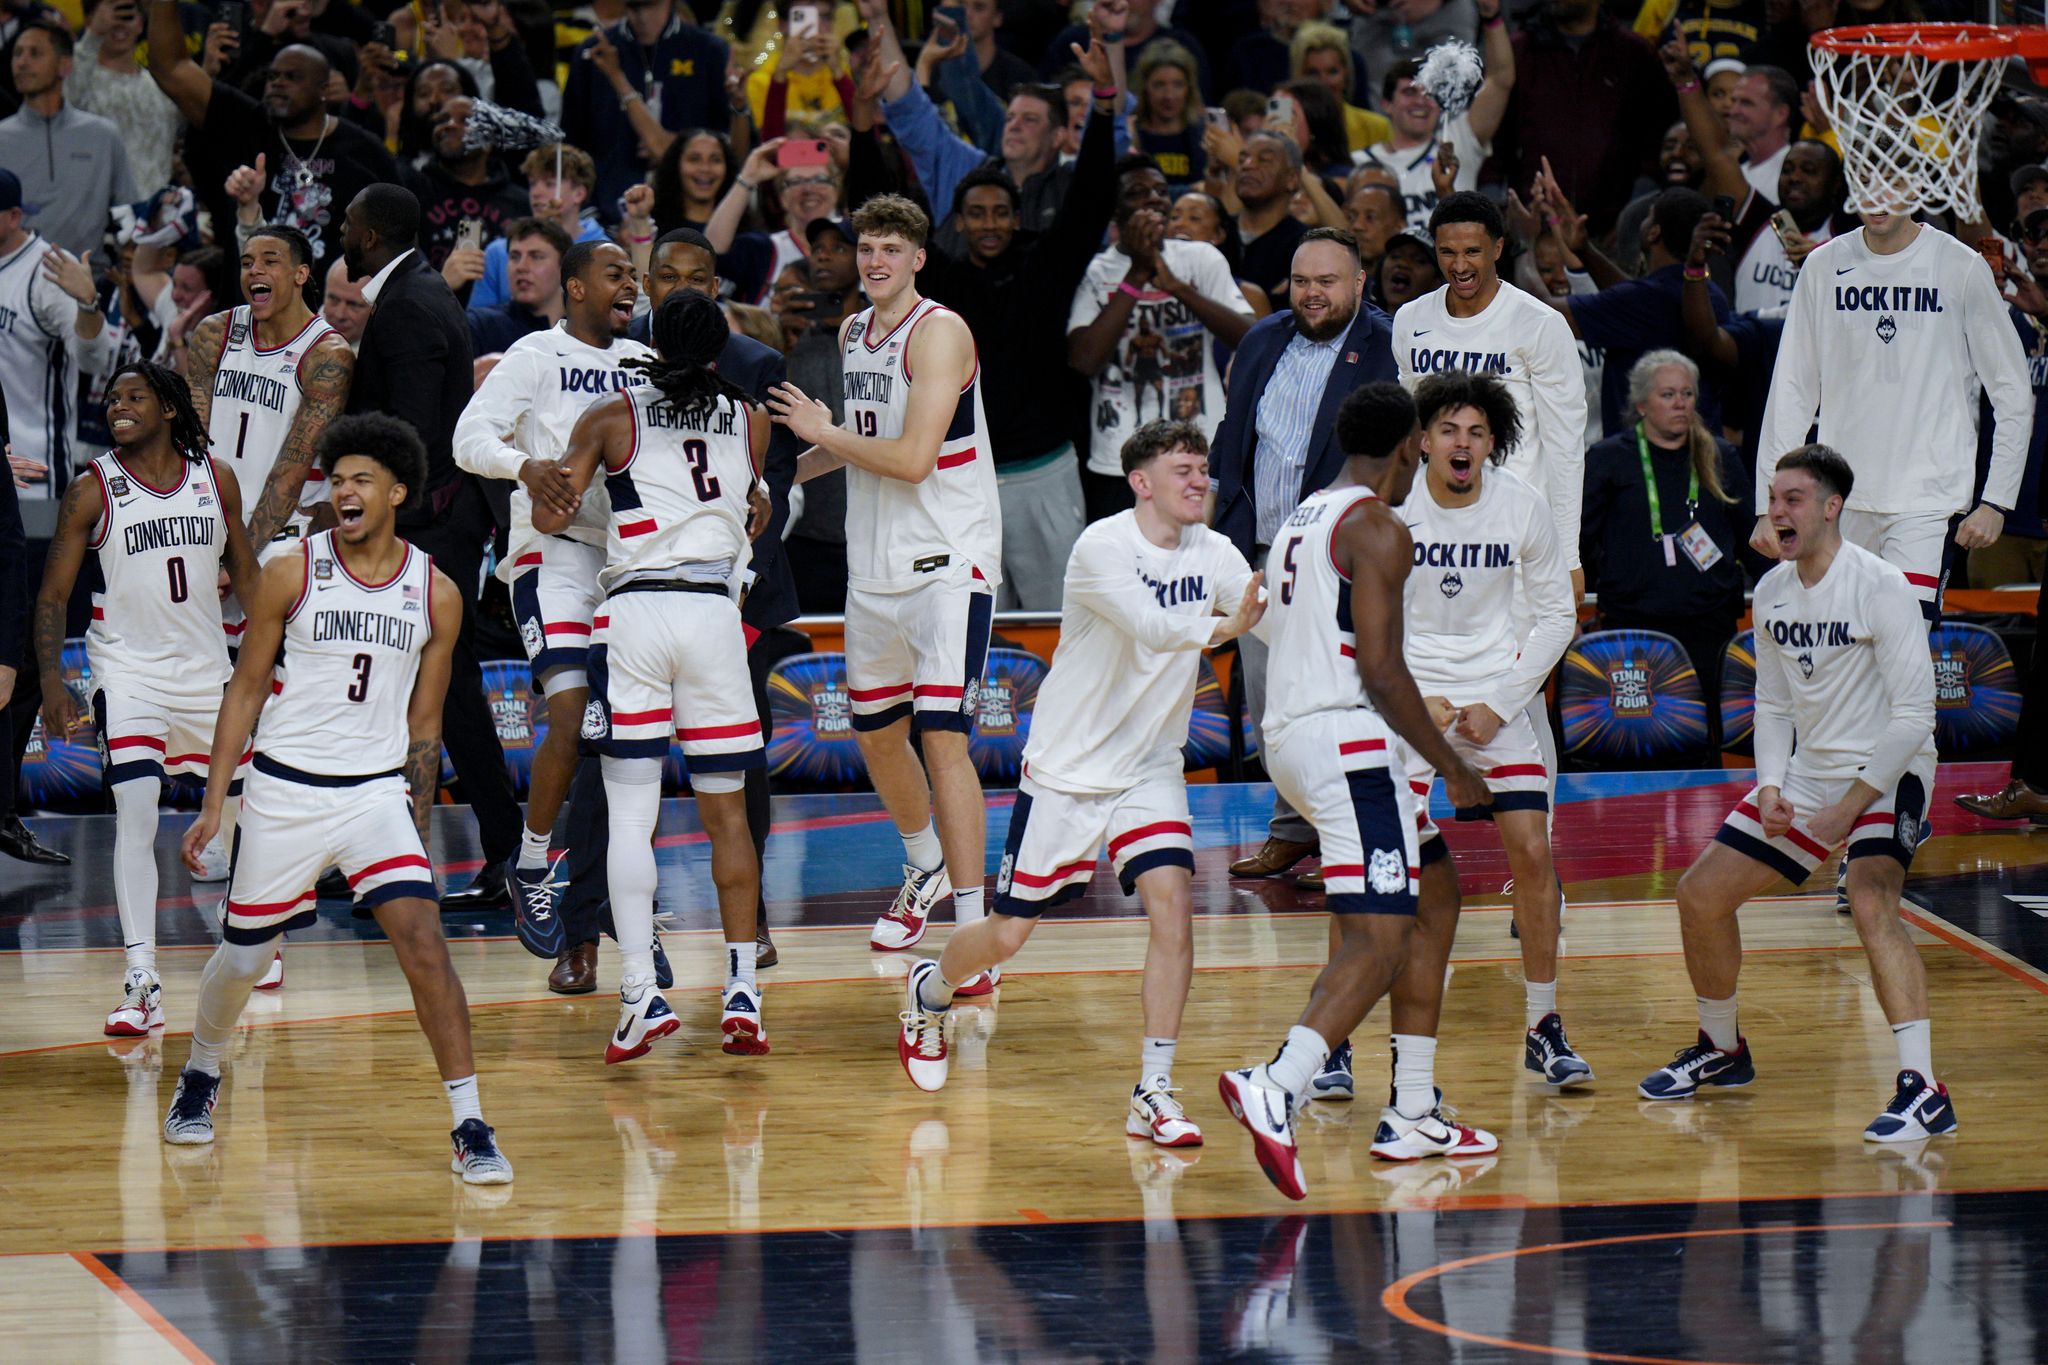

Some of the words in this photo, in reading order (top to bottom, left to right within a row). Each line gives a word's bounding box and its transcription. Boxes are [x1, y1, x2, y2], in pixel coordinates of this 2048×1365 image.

[427, 198, 512, 225] UCON
[1754, 262, 1800, 291] UCO
[1836, 286, 1889, 311] LOCK
[1893, 286, 1912, 311] IT
[1914, 287, 1944, 313] IN.
[1138, 300, 1201, 329] TYSO
[1411, 348, 1460, 373] LOCK
[1462, 352, 1483, 374] IT
[1483, 352, 1512, 374] IN.
[214, 369, 288, 414] CONNCTICUT
[560, 367, 608, 394] LOCK
[646, 405, 711, 433] DEMARY
[714, 412, 738, 436] JR.
[236, 411, 249, 459] 1
[683, 438, 722, 502] 2
[124, 516, 215, 556] CONNECTICUT
[1413, 542, 1457, 568] OCK
[1461, 543, 1481, 568] IT
[1485, 543, 1514, 568] IN.
[167, 556, 188, 603] 0
[1281, 536, 1303, 606] 5
[1181, 575, 1208, 602] IN.
[313, 610, 416, 653] CONNECTICUT
[1828, 621, 1857, 646] IN.
[348, 653, 373, 702] 3
[1611, 670, 1647, 684] FINAL
[491, 700, 528, 714] FINAL
[813, 692, 850, 706] FINAL
[979, 687, 1011, 700] FINAL
[1616, 695, 1649, 708] FOUR
[495, 725, 530, 740] FOUR
[817, 718, 850, 731] FOUR
[978, 712, 1013, 727] FOUR
[25, 740, 43, 753] UR
